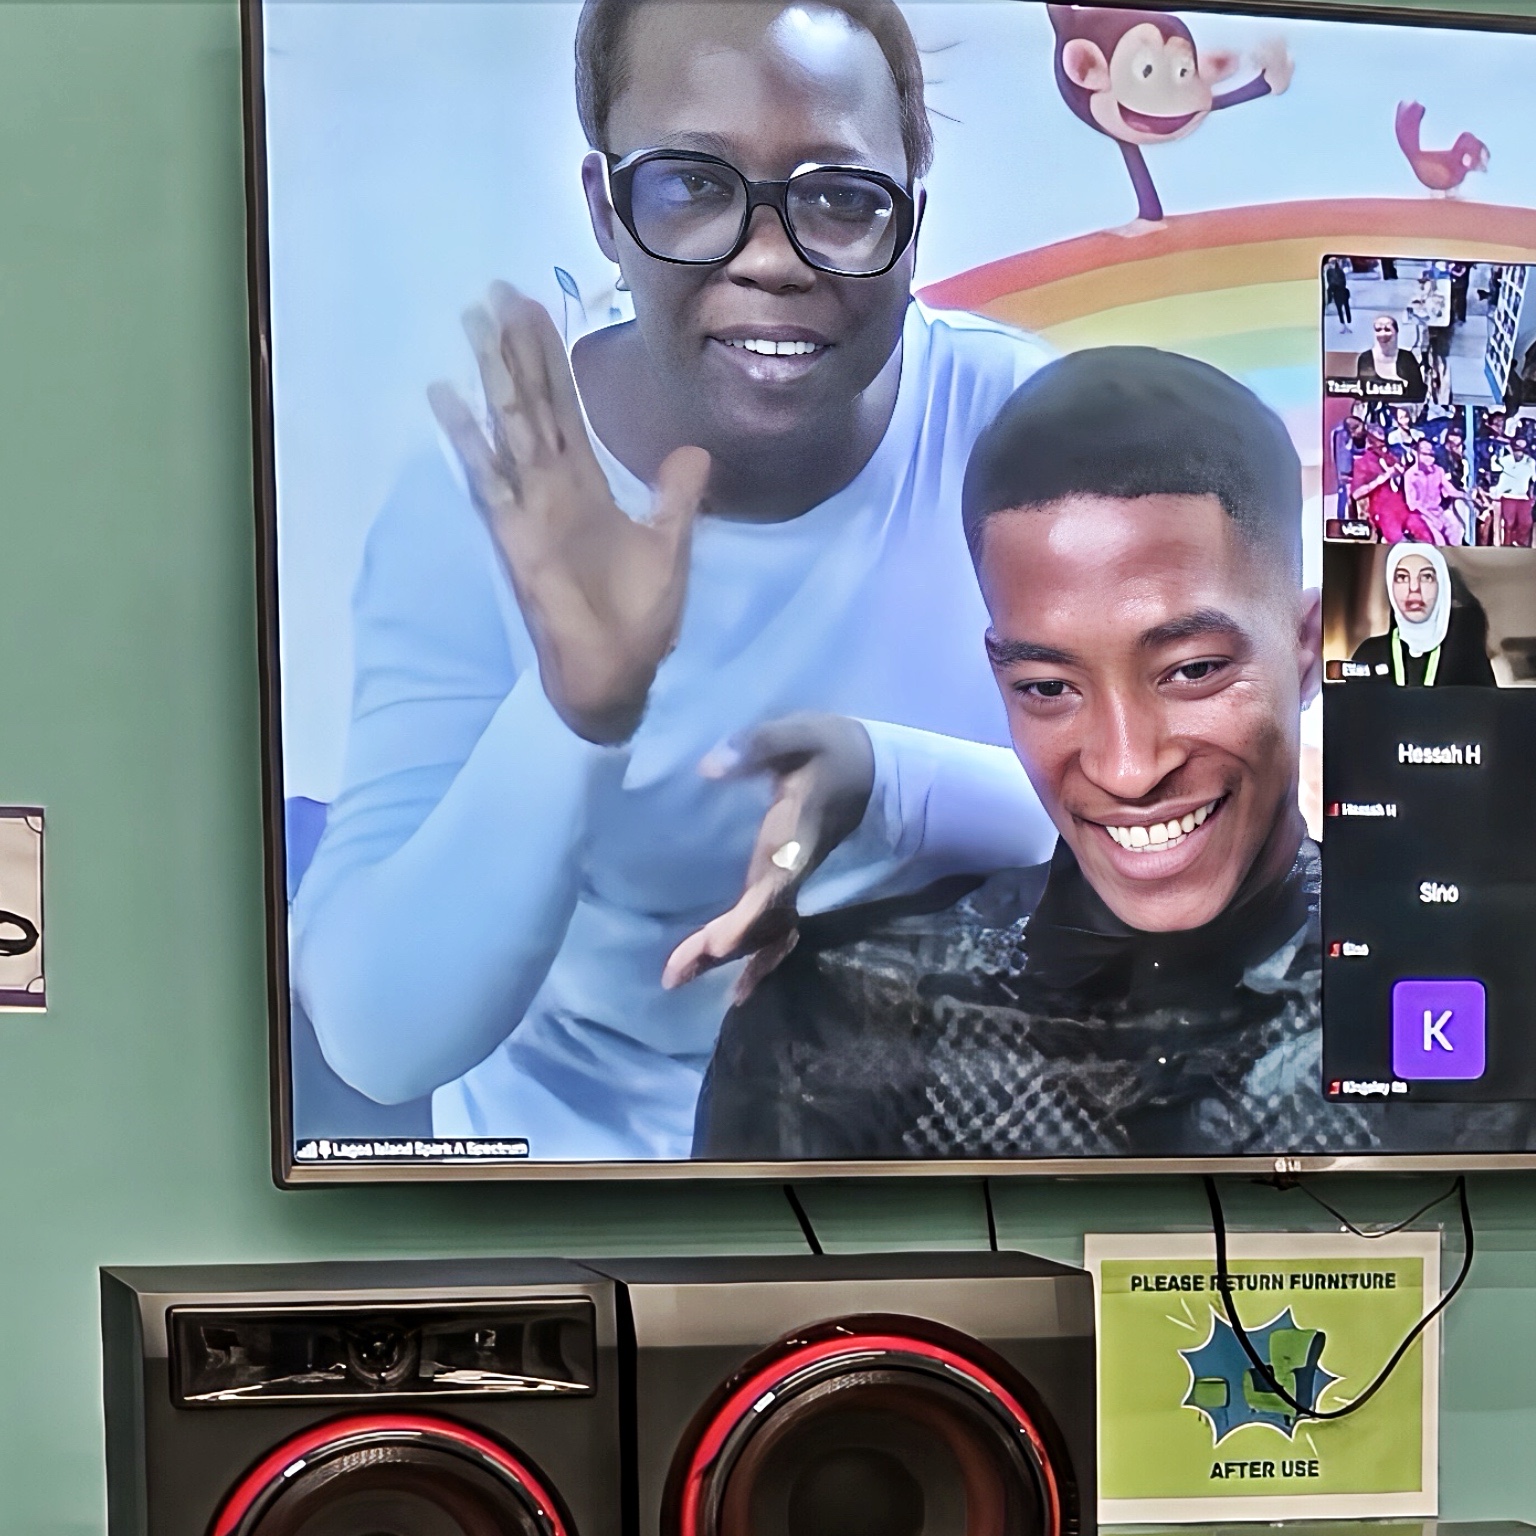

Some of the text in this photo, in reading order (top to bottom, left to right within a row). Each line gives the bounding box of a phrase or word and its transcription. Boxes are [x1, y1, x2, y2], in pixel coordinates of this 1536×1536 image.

[1465, 744, 1481, 765] H
[1423, 1010, 1454, 1052] K
[1131, 1273, 1396, 1291] PLEASE RETURN FURNITURE
[1210, 1460, 1320, 1479] AFTER USE
